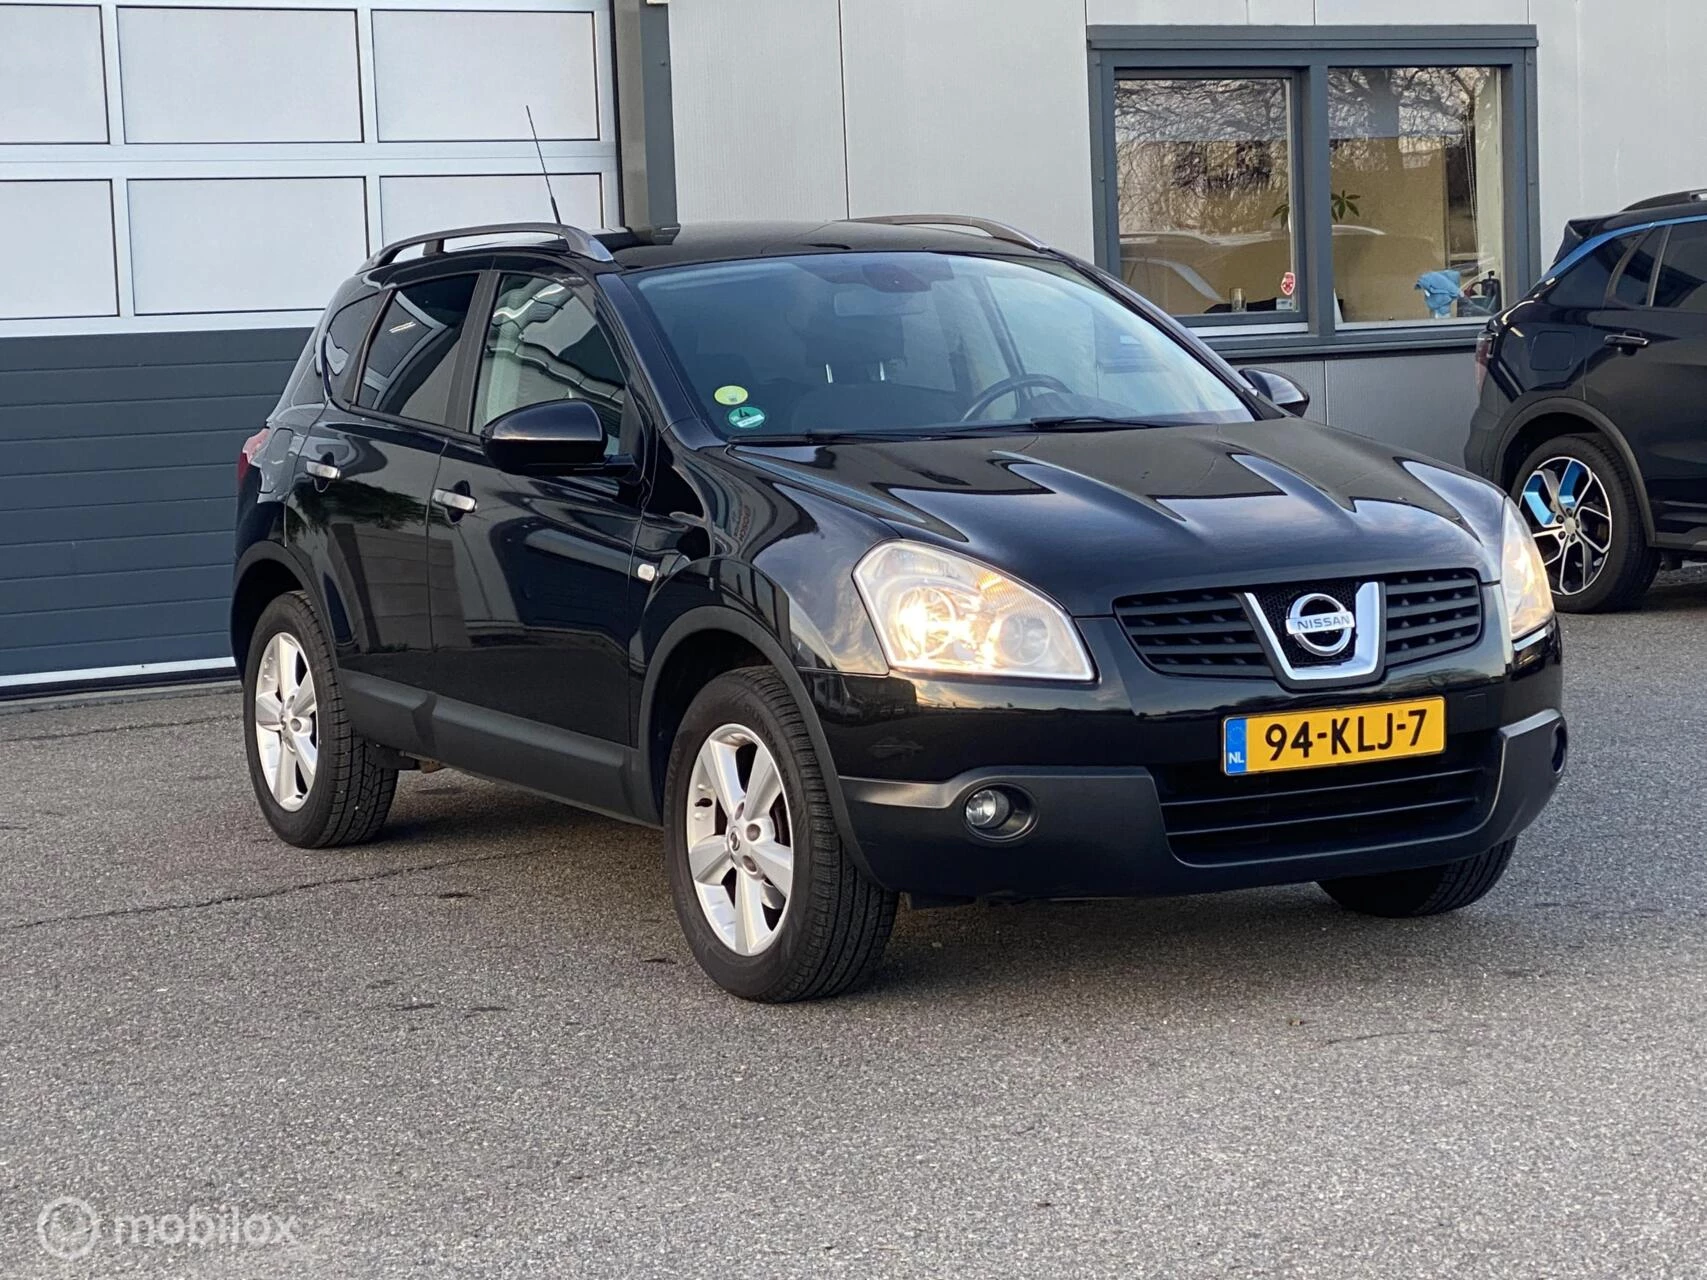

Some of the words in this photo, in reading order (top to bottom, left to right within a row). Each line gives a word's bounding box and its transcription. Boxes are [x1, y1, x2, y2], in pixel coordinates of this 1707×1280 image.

[1297, 615, 1351, 631] NISSAN
[1264, 708, 1428, 762] 94-KLJ-7
[1228, 752, 1245, 764] NL
